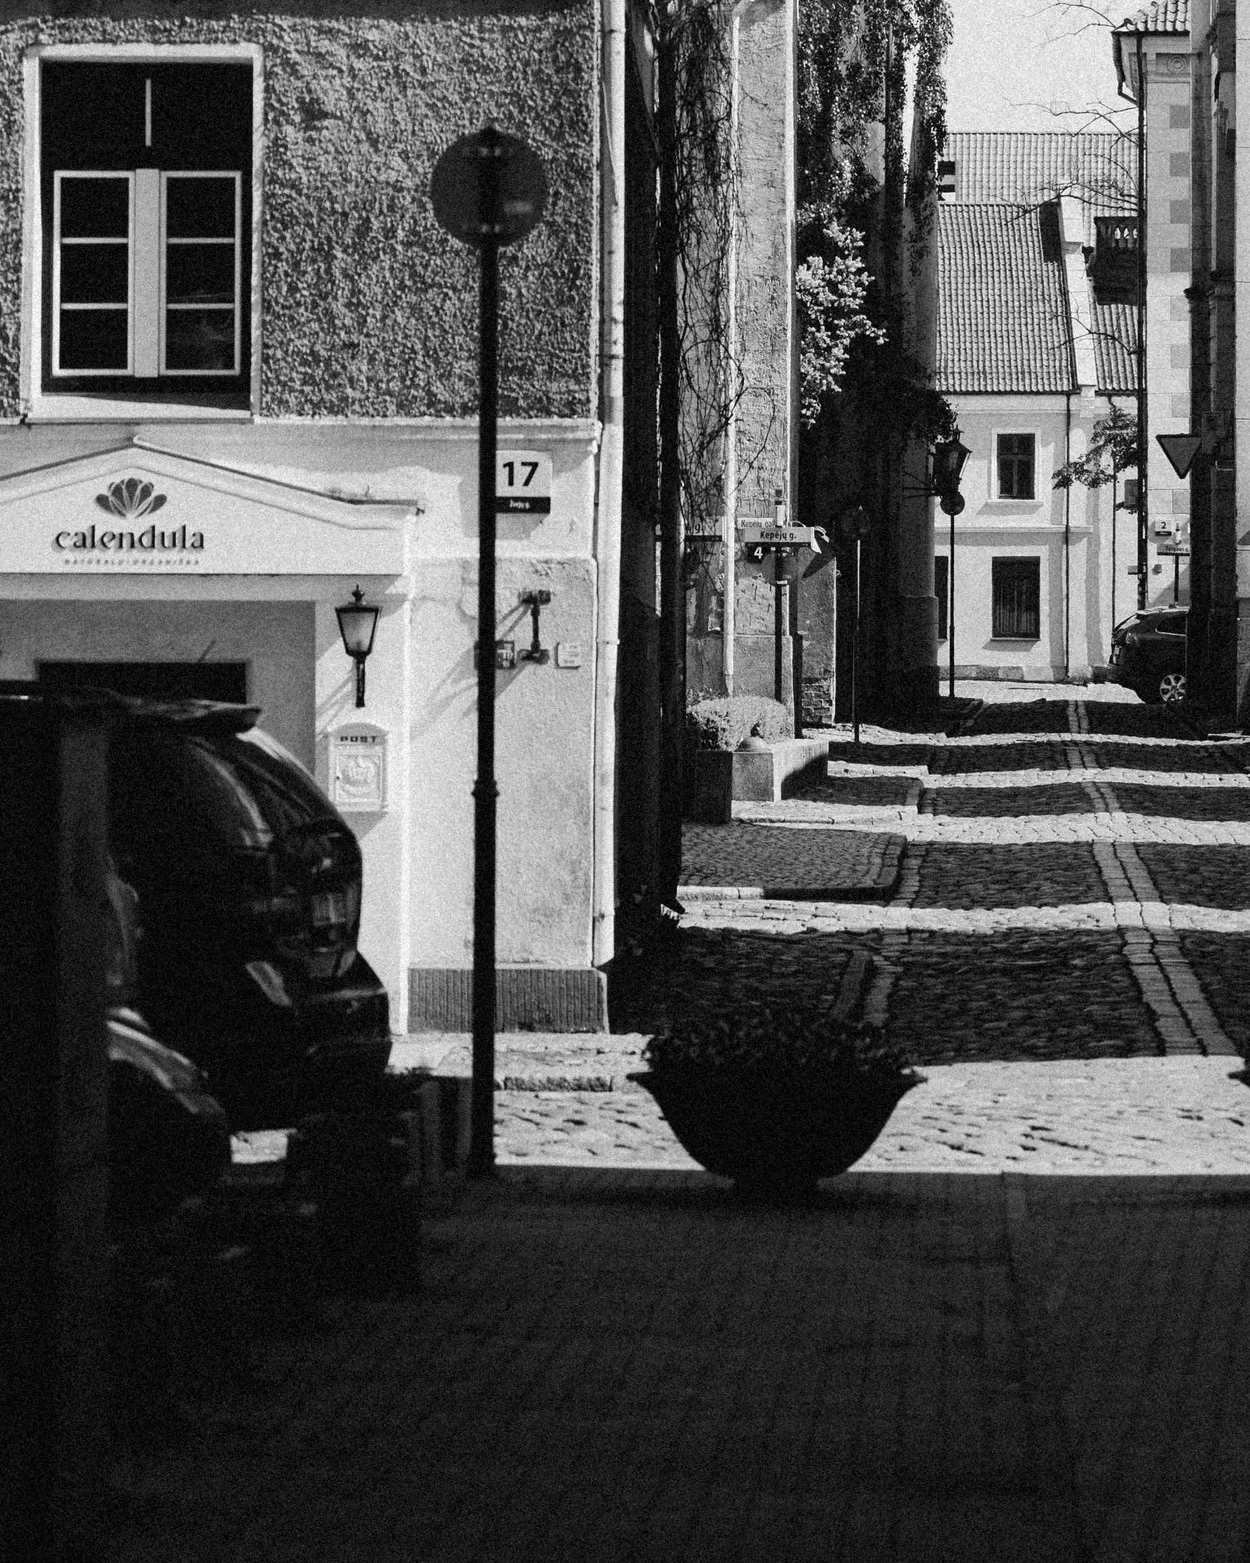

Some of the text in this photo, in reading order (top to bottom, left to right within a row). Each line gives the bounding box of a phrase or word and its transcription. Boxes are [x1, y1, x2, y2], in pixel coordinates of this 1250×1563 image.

[503, 461, 539, 487] 17
[1161, 521, 1167, 529] 2
[55, 525, 205, 550] calendula
[760, 530, 787, 541] Kepėjų
[753, 546, 764, 559] 4
[340, 735, 377, 744] POST
